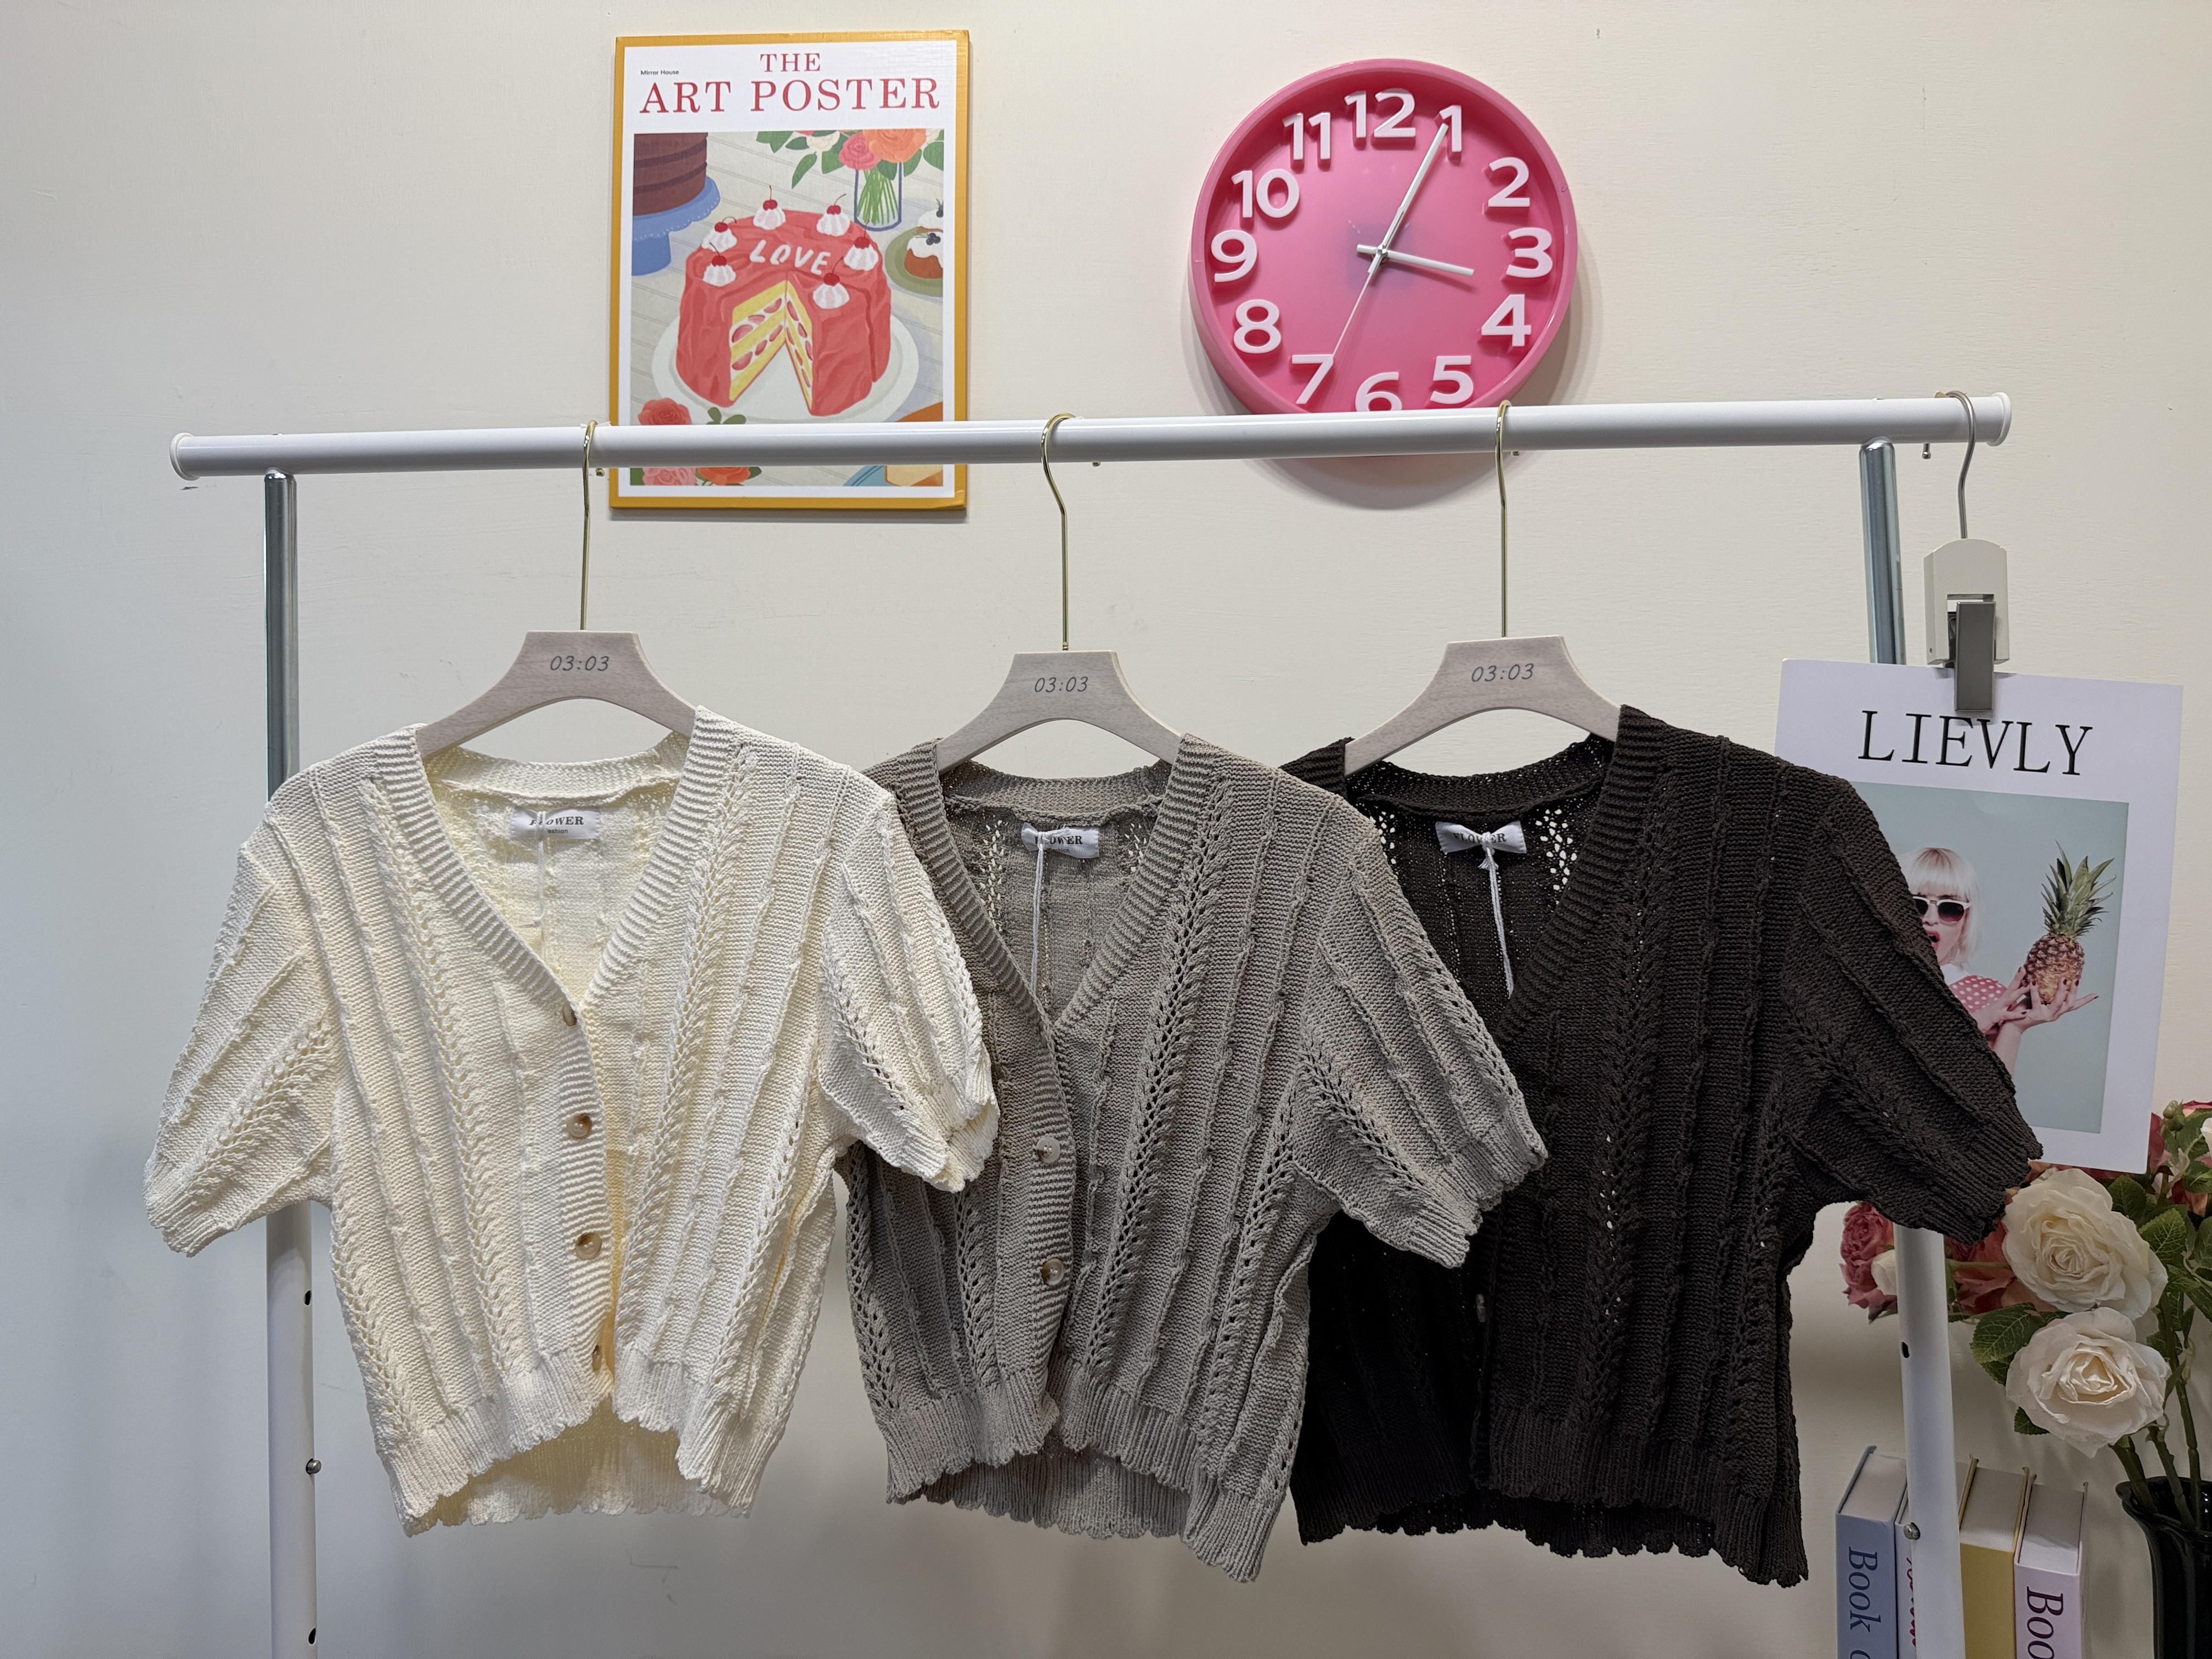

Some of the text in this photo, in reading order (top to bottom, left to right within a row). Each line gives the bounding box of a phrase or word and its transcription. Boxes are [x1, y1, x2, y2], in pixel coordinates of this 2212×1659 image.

[760, 53, 821, 72] THE
[639, 77, 940, 114] ART POSTER
[1344, 89, 1416, 138] 12
[1283, 111, 1331, 160] 11
[1438, 104, 1462, 153] 1
[1231, 167, 1300, 218] 10
[1487, 156, 1530, 207] 2
[749, 239, 832, 275] LOVE
[1210, 229, 1258, 283] 9
[1506, 227, 1553, 278] 3
[1233, 298, 1282, 354] 8
[1481, 294, 1531, 347] 4
[1291, 353, 1334, 405] 7
[1430, 354, 1474, 405] 5
[550, 655, 610, 672] 03:03
[1034, 676, 1088, 693] 03:03
[1471, 663, 1534, 682] 03:03
[1858, 710, 2093, 776] LIEVLY
[1849, 1546, 1881, 1633] Book
